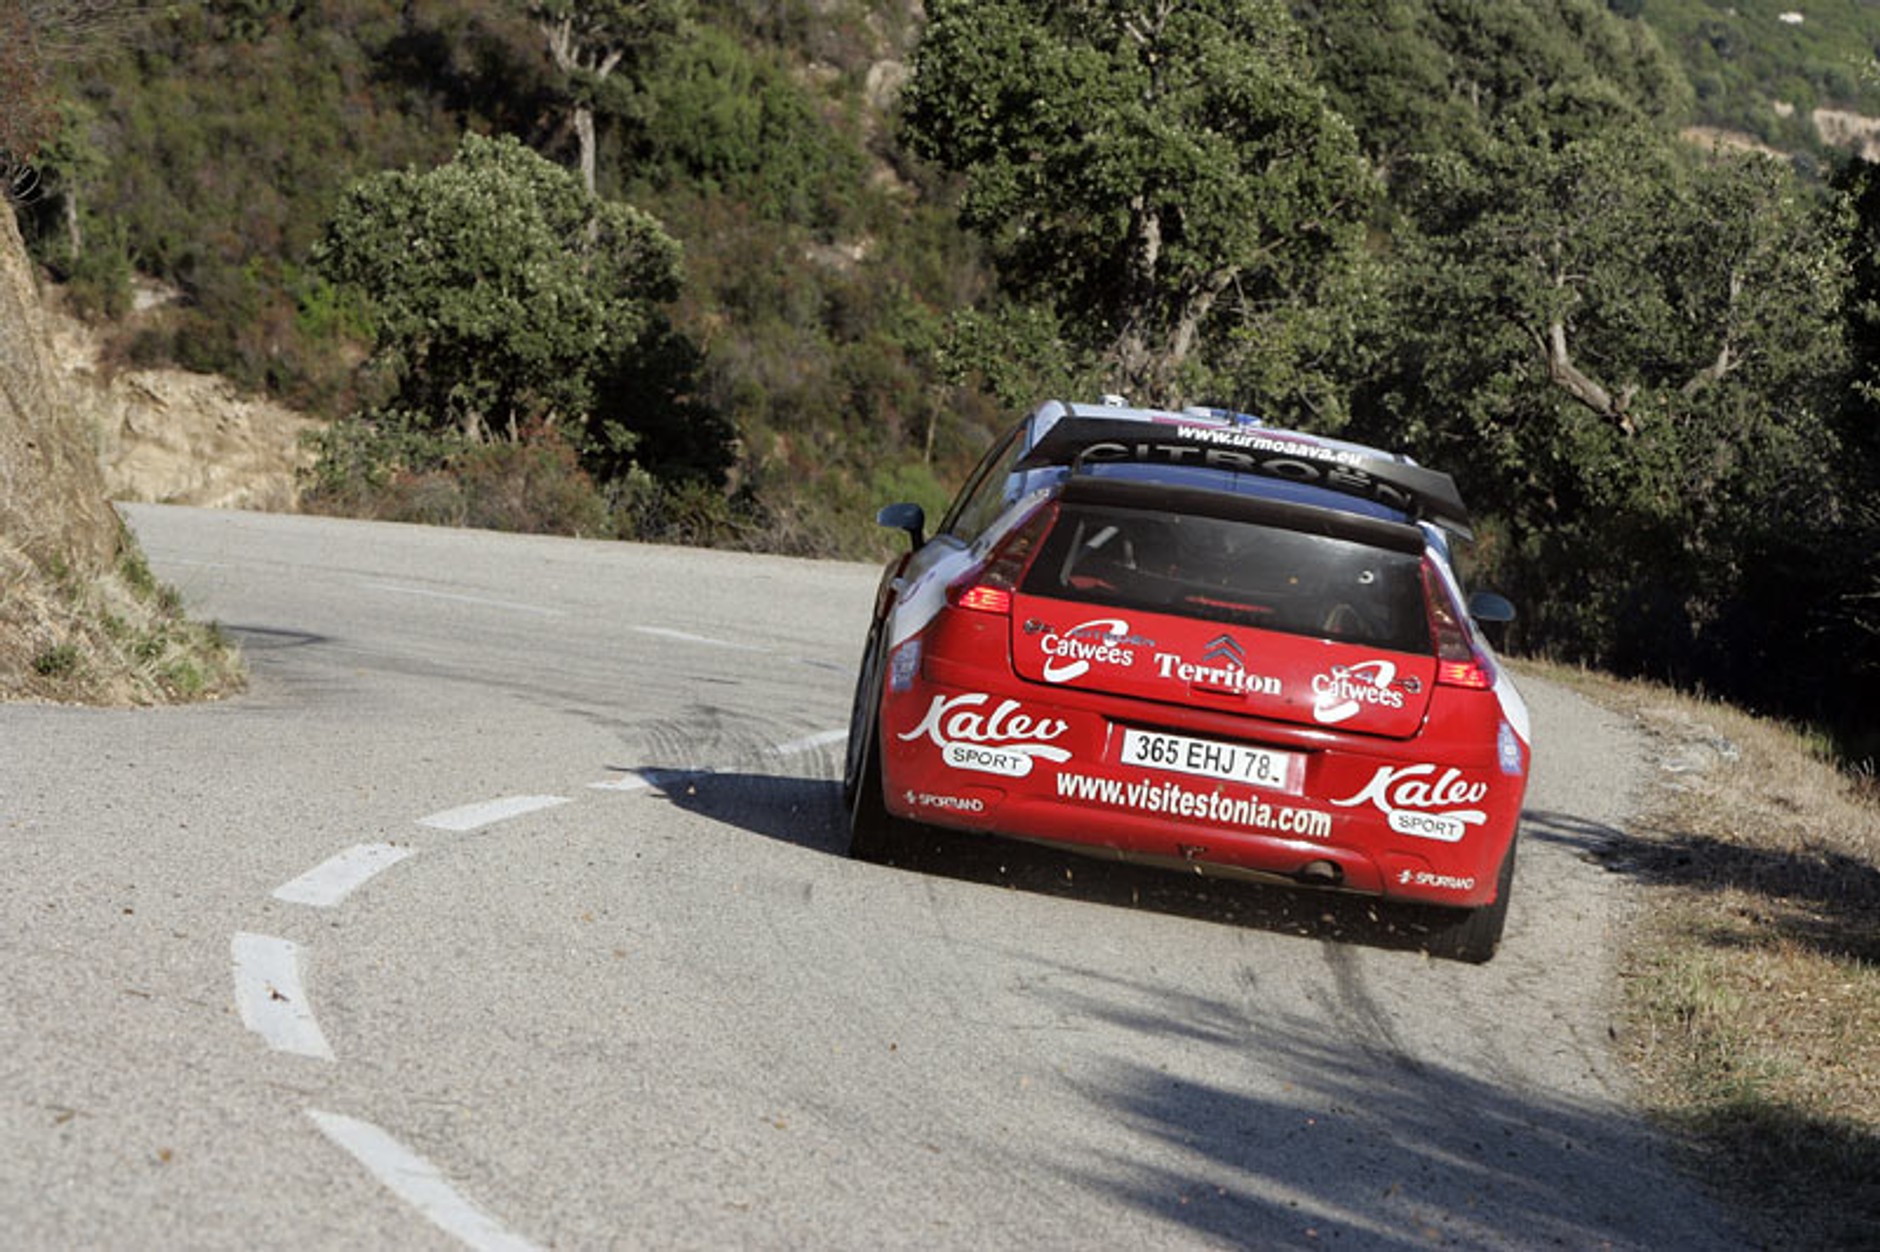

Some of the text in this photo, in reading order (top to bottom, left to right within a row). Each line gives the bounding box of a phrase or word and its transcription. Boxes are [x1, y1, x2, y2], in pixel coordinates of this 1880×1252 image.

[1176, 424, 1363, 466] www.urmoaava.eu
[1040, 633, 1134, 666] Catwees
[1153, 652, 1282, 696] Territon
[1311, 673, 1404, 709] Catwees
[897, 692, 1069, 749] Kalev
[952, 747, 1023, 770] SPORT
[1136, 734, 1180, 765] 365
[1186, 741, 1236, 775] EHJ
[1056, 771, 1332, 838] www.visitestonia.com
[1329, 763, 1488, 815] Kalev
[1397, 815, 1458, 836] SPORT
